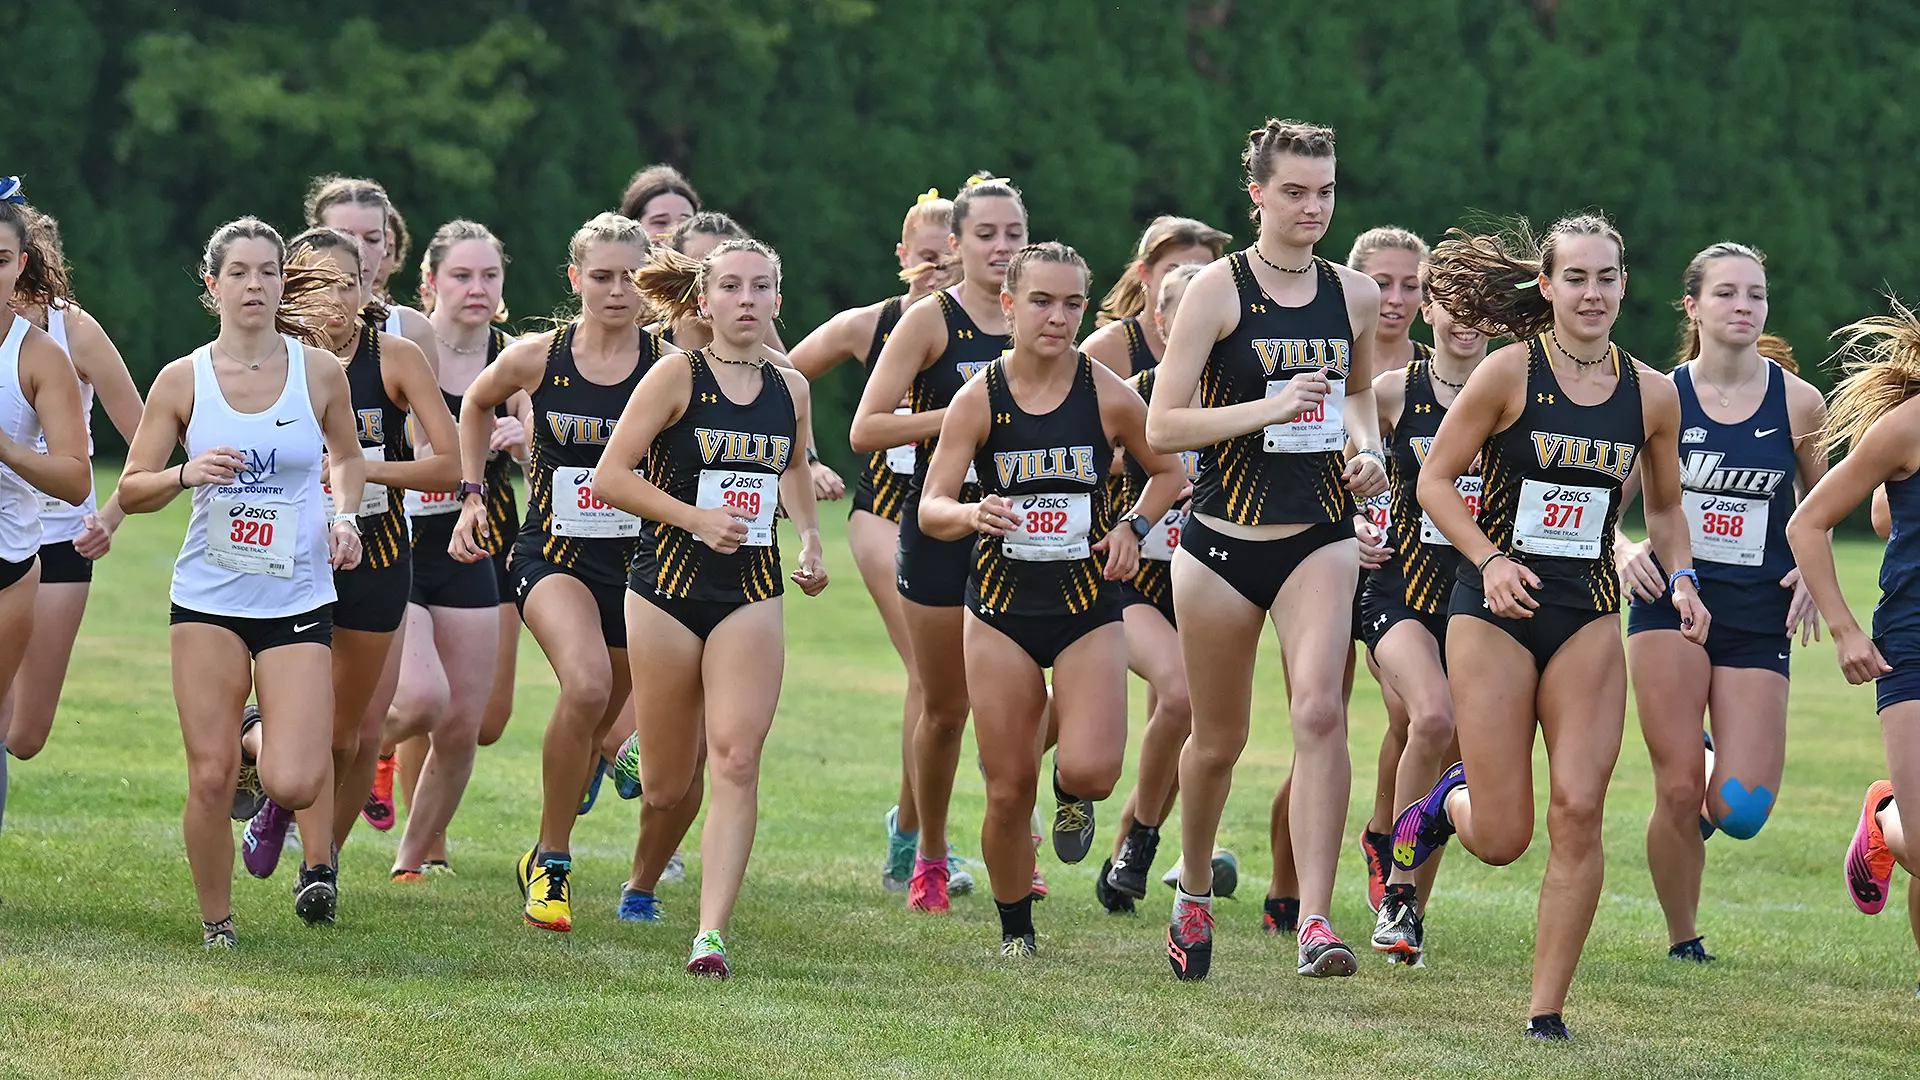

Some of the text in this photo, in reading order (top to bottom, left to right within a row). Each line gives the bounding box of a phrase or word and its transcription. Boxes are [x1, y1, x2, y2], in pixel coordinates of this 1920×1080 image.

[1252, 338, 1350, 379] VILLE
[546, 411, 619, 446] VIL
[694, 427, 790, 474] VILLE
[1530, 430, 1636, 482] VILLE
[994, 446, 1098, 489] VILLE
[1685, 449, 1786, 496] VALLEY
[218, 486, 284, 495] CROSS COUNTRY
[723, 490, 761, 516] 369
[1037, 498, 1069, 509] asics
[1559, 490, 1591, 503] asics
[245, 507, 277, 520] asics
[1543, 503, 1584, 529] 371
[1716, 502, 1747, 513] asics
[230, 519, 273, 547] 320
[1026, 511, 1068, 534] 382
[1703, 512, 1744, 537] 358
